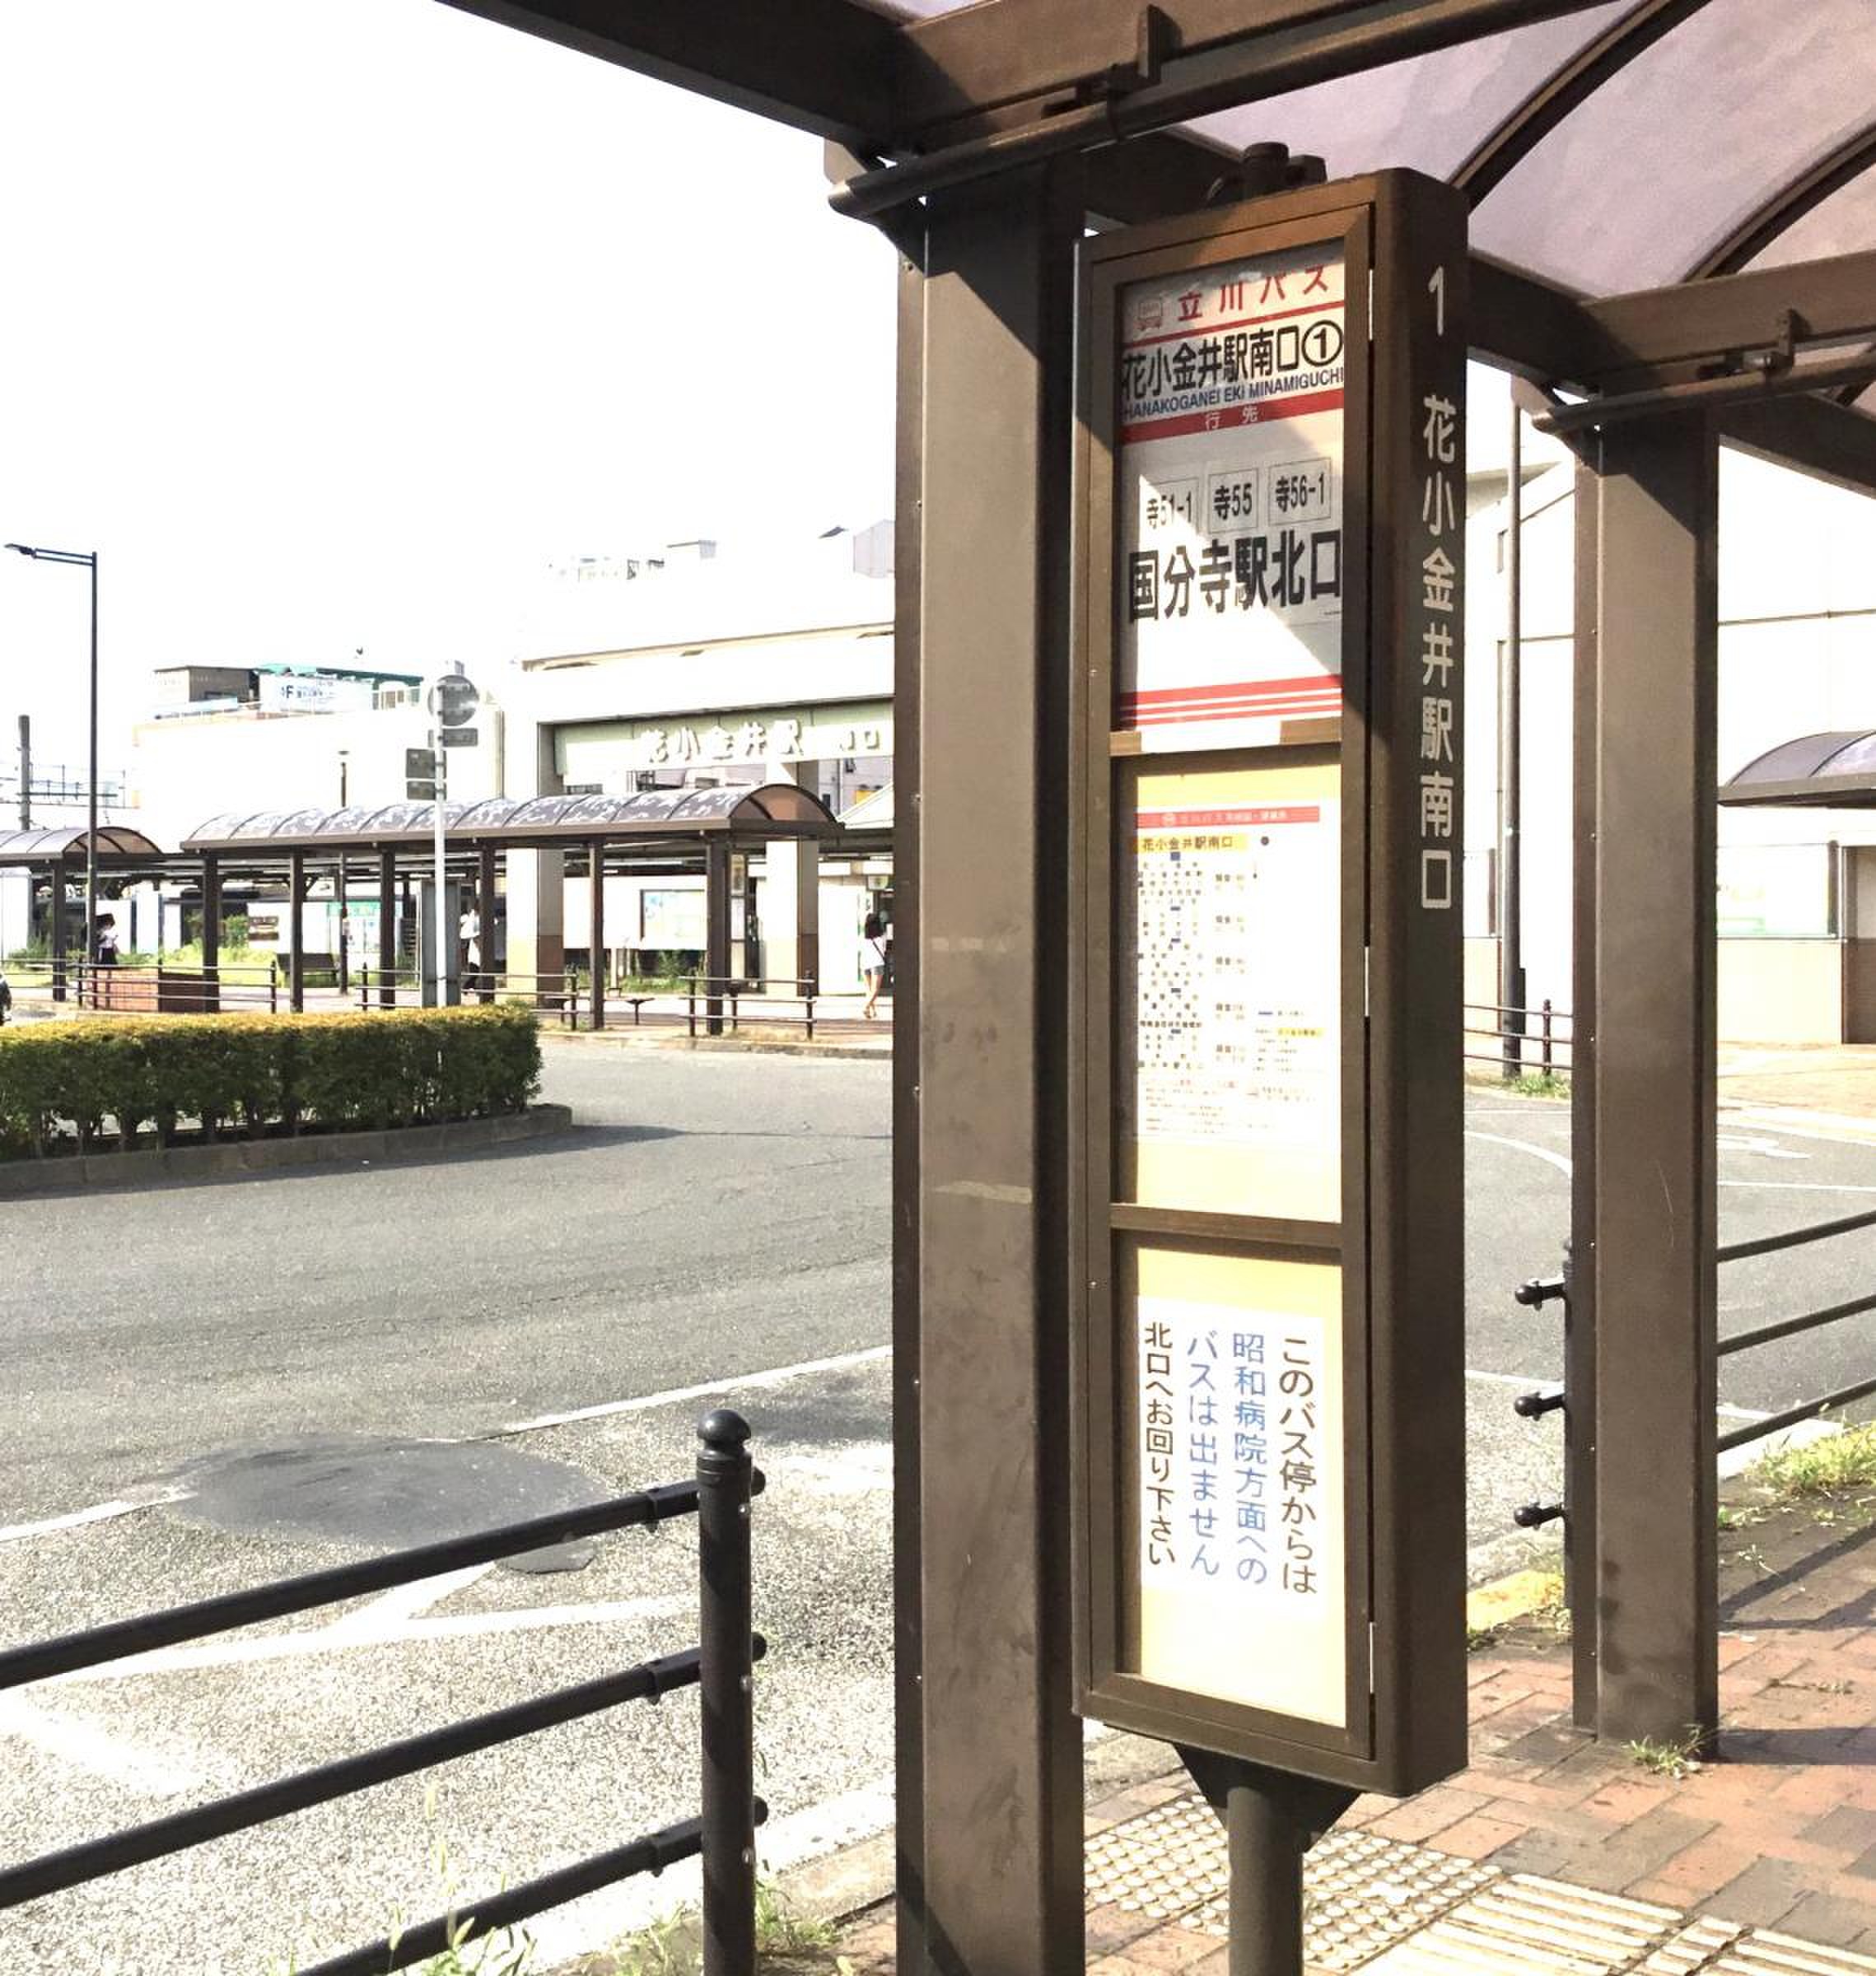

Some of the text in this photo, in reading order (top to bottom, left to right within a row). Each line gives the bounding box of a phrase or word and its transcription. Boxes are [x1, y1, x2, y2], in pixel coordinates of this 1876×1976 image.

[1178, 264, 1329, 321] 立川バス
[1427, 264, 1444, 336] 1
[1124, 367, 1344, 419] HANAKOGANEI EKI MINAMIGUCHI
[1214, 482, 1253, 520] 寺55
[1275, 472, 1325, 513] 寺56-1
[1129, 529, 1342, 624] 国分寺駅北口
[1420, 394, 1457, 909] 花小金井駅南口
[1145, 1321, 1176, 1566] 北口へお回り下さい
[1188, 1330, 1220, 1577] バスは出ません
[1232, 1332, 1268, 1586] 昭和病院方面への
[1279, 1336, 1317, 1595] このバス停からは
